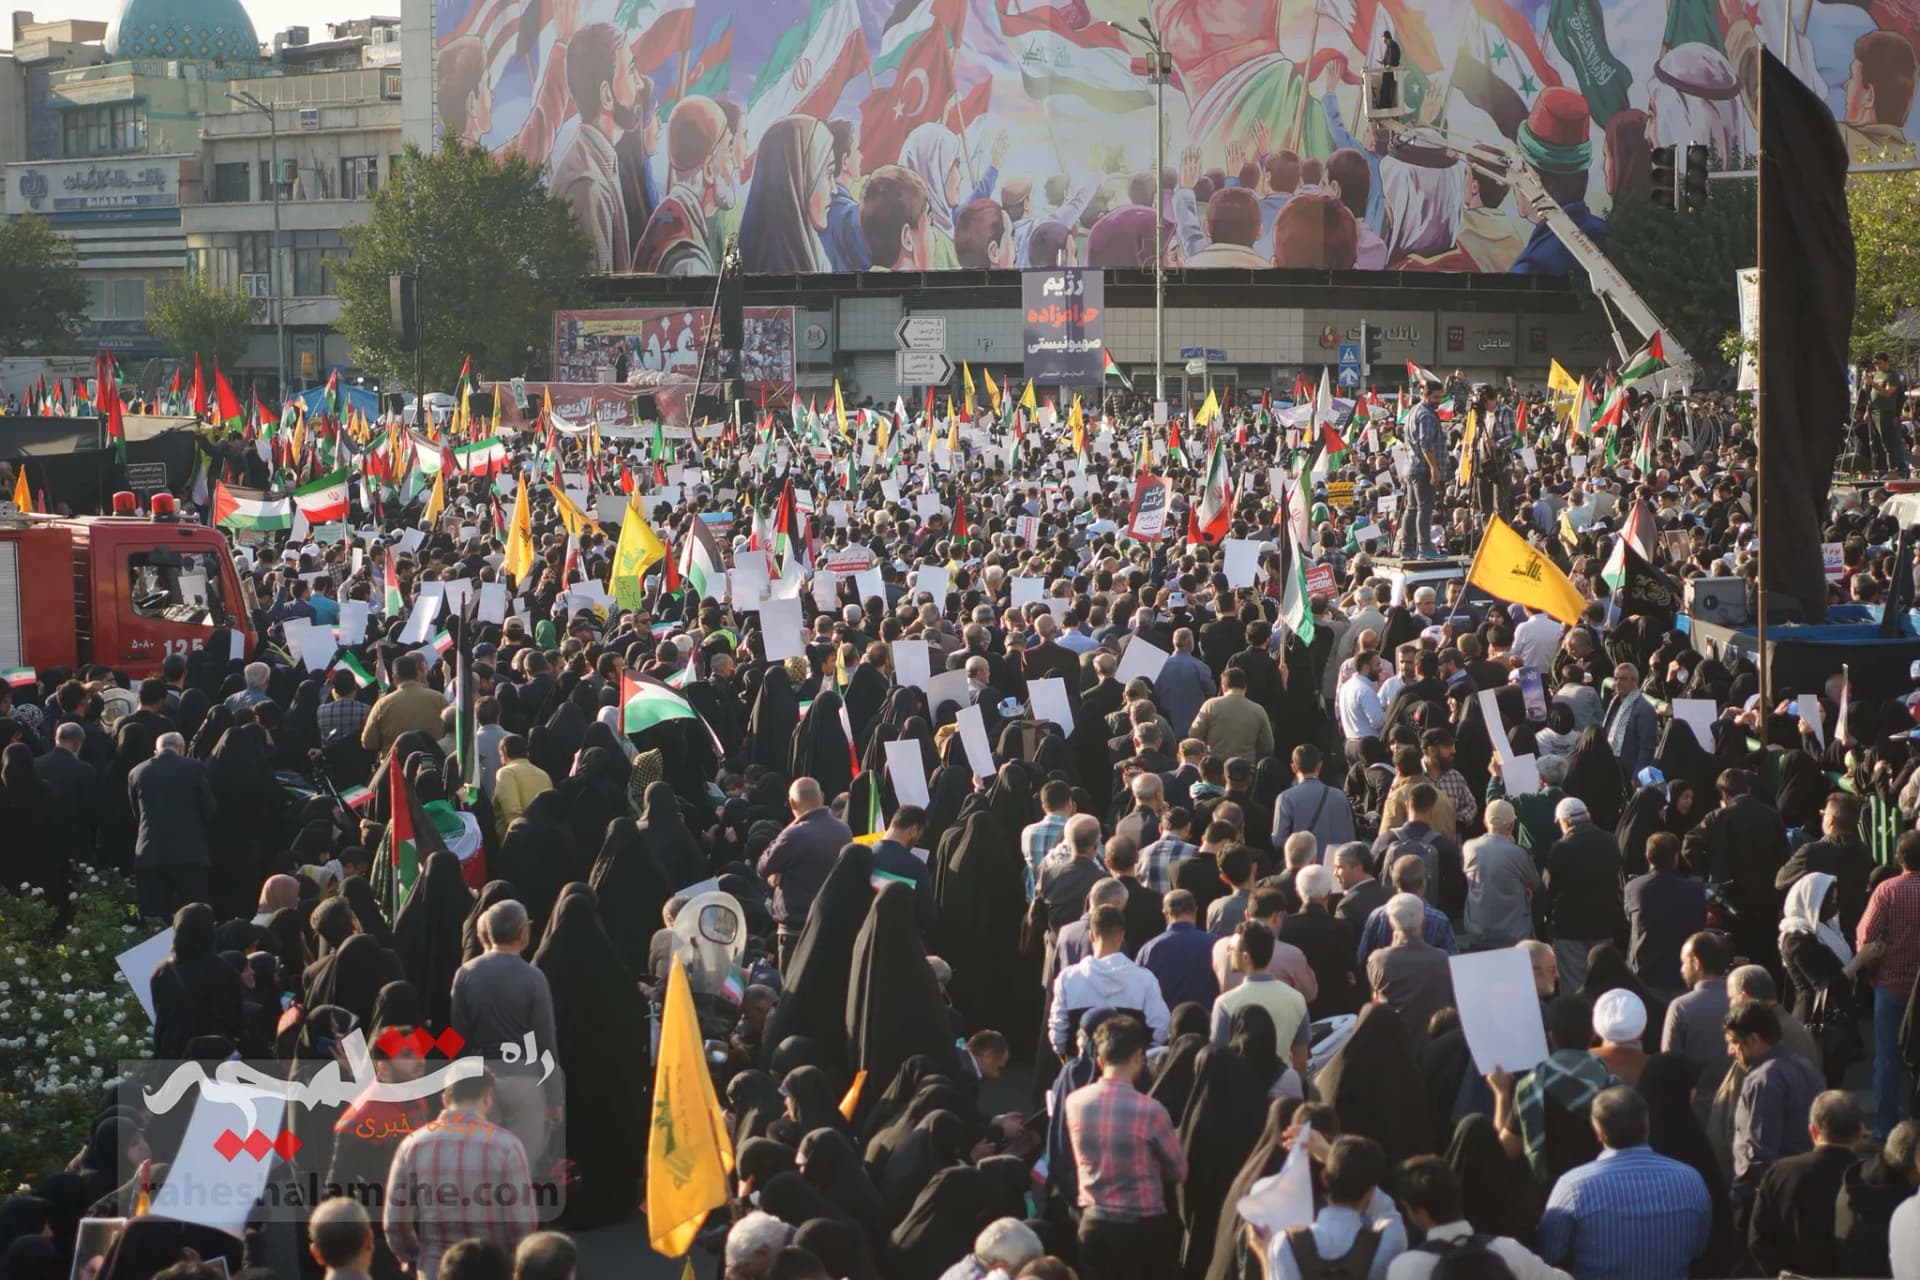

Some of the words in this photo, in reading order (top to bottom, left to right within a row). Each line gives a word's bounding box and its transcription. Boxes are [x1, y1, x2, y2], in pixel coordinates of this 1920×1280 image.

[1043, 270, 1084, 296] رژیم
[1027, 303, 1100, 328] حرامزاده
[1027, 335, 1101, 354] صهیونیستی
[1386, 325, 1420, 348] بانک
[163, 638, 204, 657] 125
